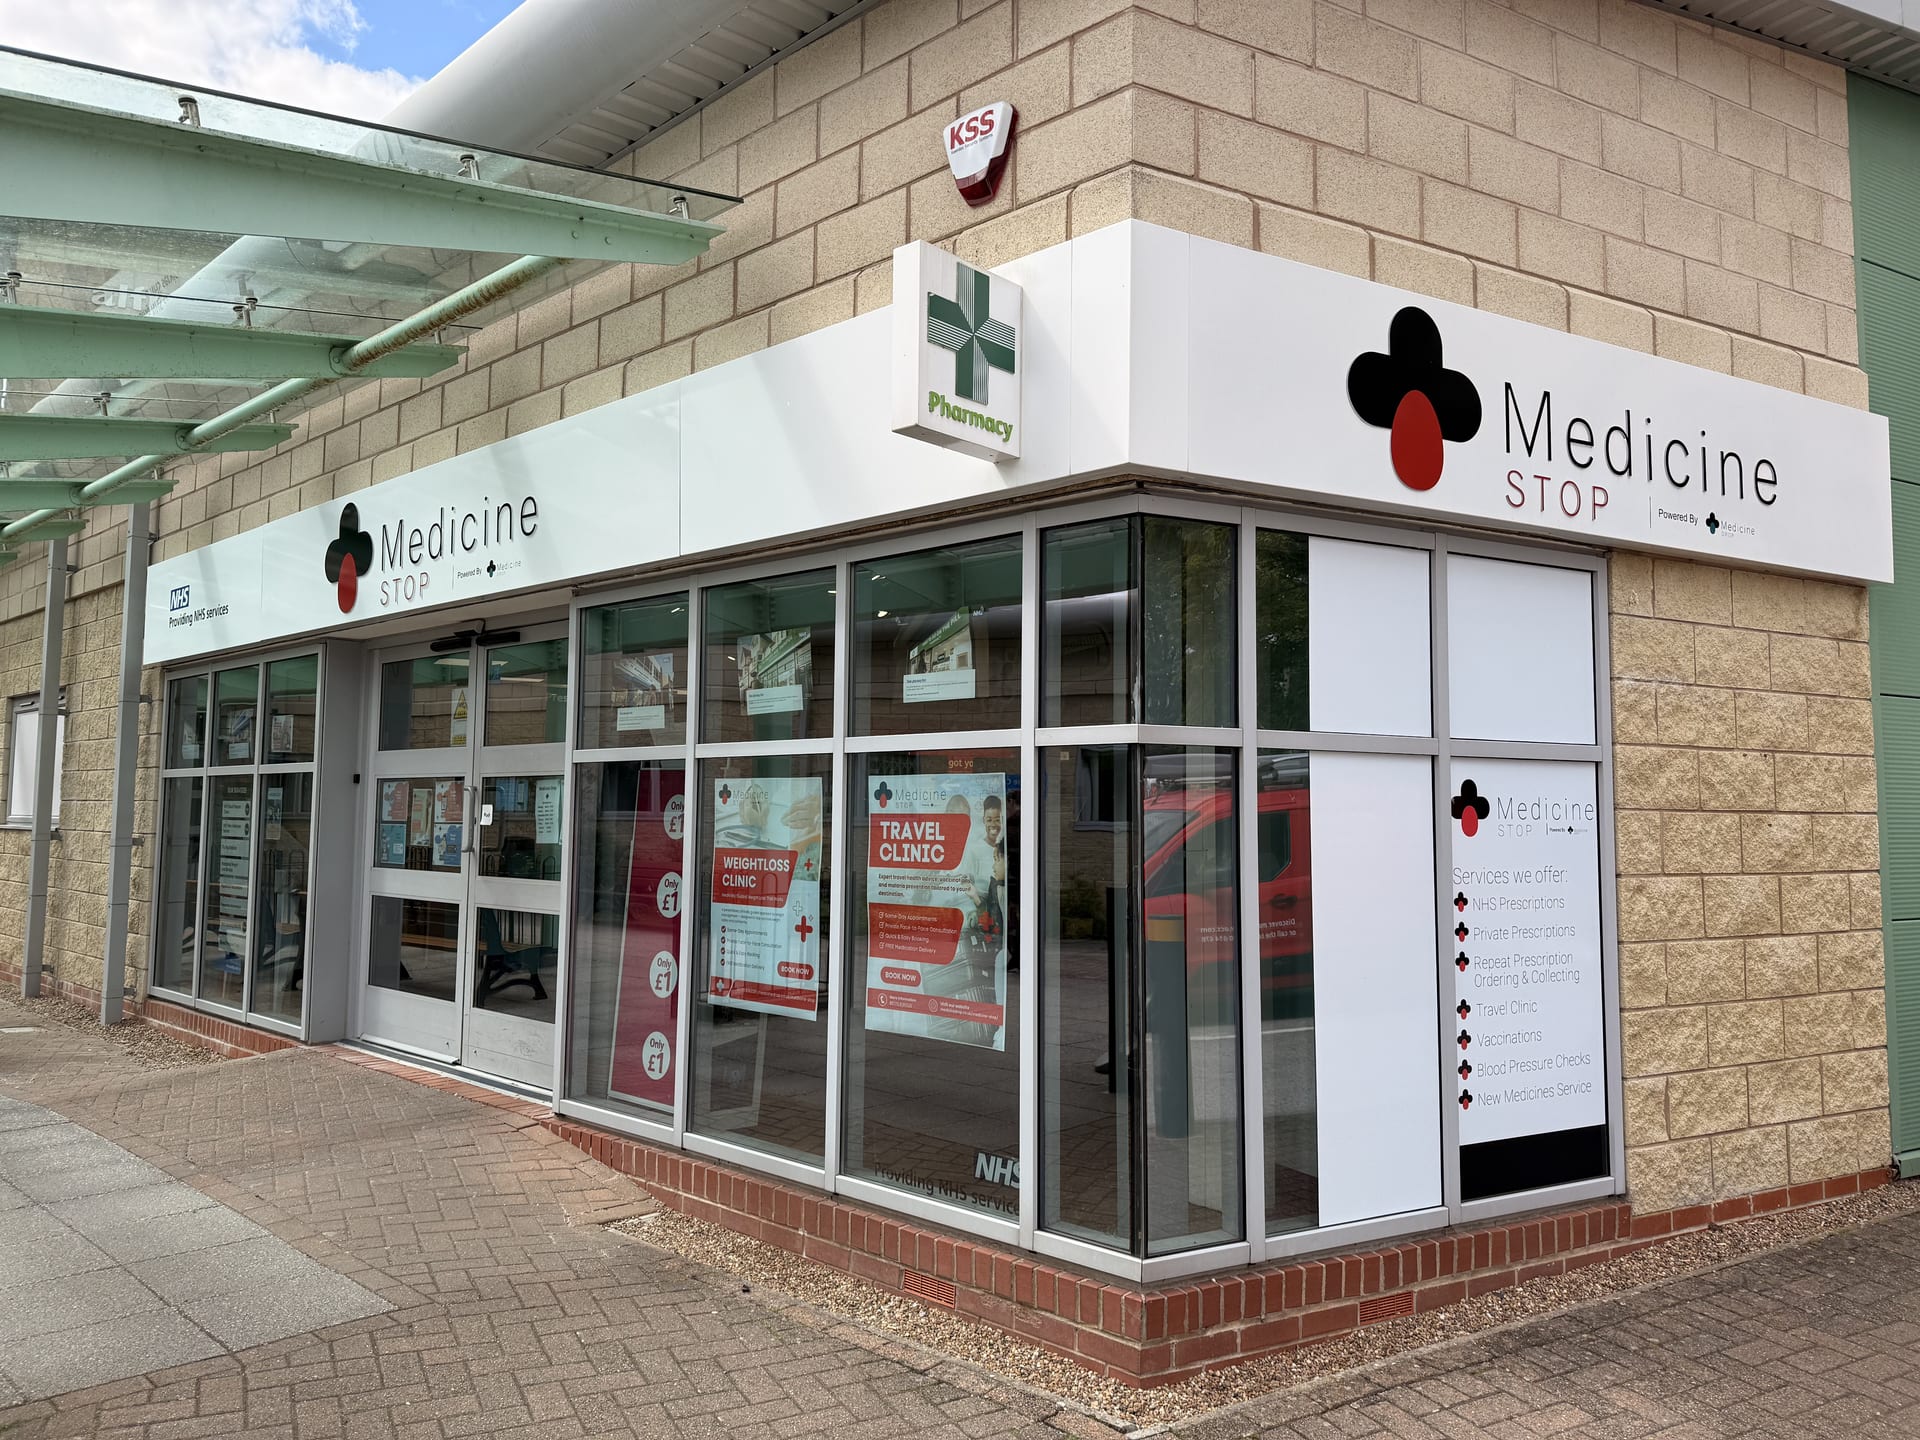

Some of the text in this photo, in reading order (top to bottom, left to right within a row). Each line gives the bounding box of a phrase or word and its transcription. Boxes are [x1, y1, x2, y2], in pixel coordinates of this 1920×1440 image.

[950, 109, 994, 150] KSS
[928, 391, 1014, 443] Pharmacy
[1504, 382, 1779, 506] Medicine
[1506, 470, 1610, 521] STOP
[1658, 508, 1698, 526] Powered By
[381, 496, 538, 572] Medicine
[1720, 521, 1756, 536] Medicine
[457, 568, 482, 579] Powered By
[170, 586, 190, 611] NHS
[380, 572, 430, 606] STOP
[169, 604, 229, 628] Providing NHS services
[948, 760, 963, 769] got
[896, 789, 947, 801] Medicine
[671, 801, 684, 814] Only
[1497, 797, 1594, 821] Medicine
[669, 814, 684, 833] £1
[880, 821, 945, 841] TRAVEL
[1498, 824, 1533, 837] STOP
[879, 843, 945, 863] CLINIC
[724, 856, 790, 872] WEIGHTLOSS
[722, 874, 756, 888] CLINIC
[1453, 865, 1568, 885] Services we offer:
[664, 878, 679, 892] Only
[662, 891, 678, 912] £1
[1472, 896, 1565, 912] NHS Prescriptions
[1473, 924, 1576, 941] Private Prescriptions
[656, 957, 672, 970] Only
[1474, 952, 1573, 972] Repeat Prescription
[655, 971, 671, 992] £1
[885, 972, 916, 982] BOOK NOW
[1474, 969, 1580, 988] Ordering & Collecting
[1477, 1000, 1538, 1017] Travel Clinic
[650, 1038, 664, 1050] Only
[1477, 1030, 1542, 1047] Vaccinations
[648, 1052, 664, 1073] £1
[1477, 1052, 1591, 1078] Blood Pressure Checks
[1478, 1081, 1592, 1107] New Medicines Service
[874, 1162, 1020, 1217] Providing NHS service
